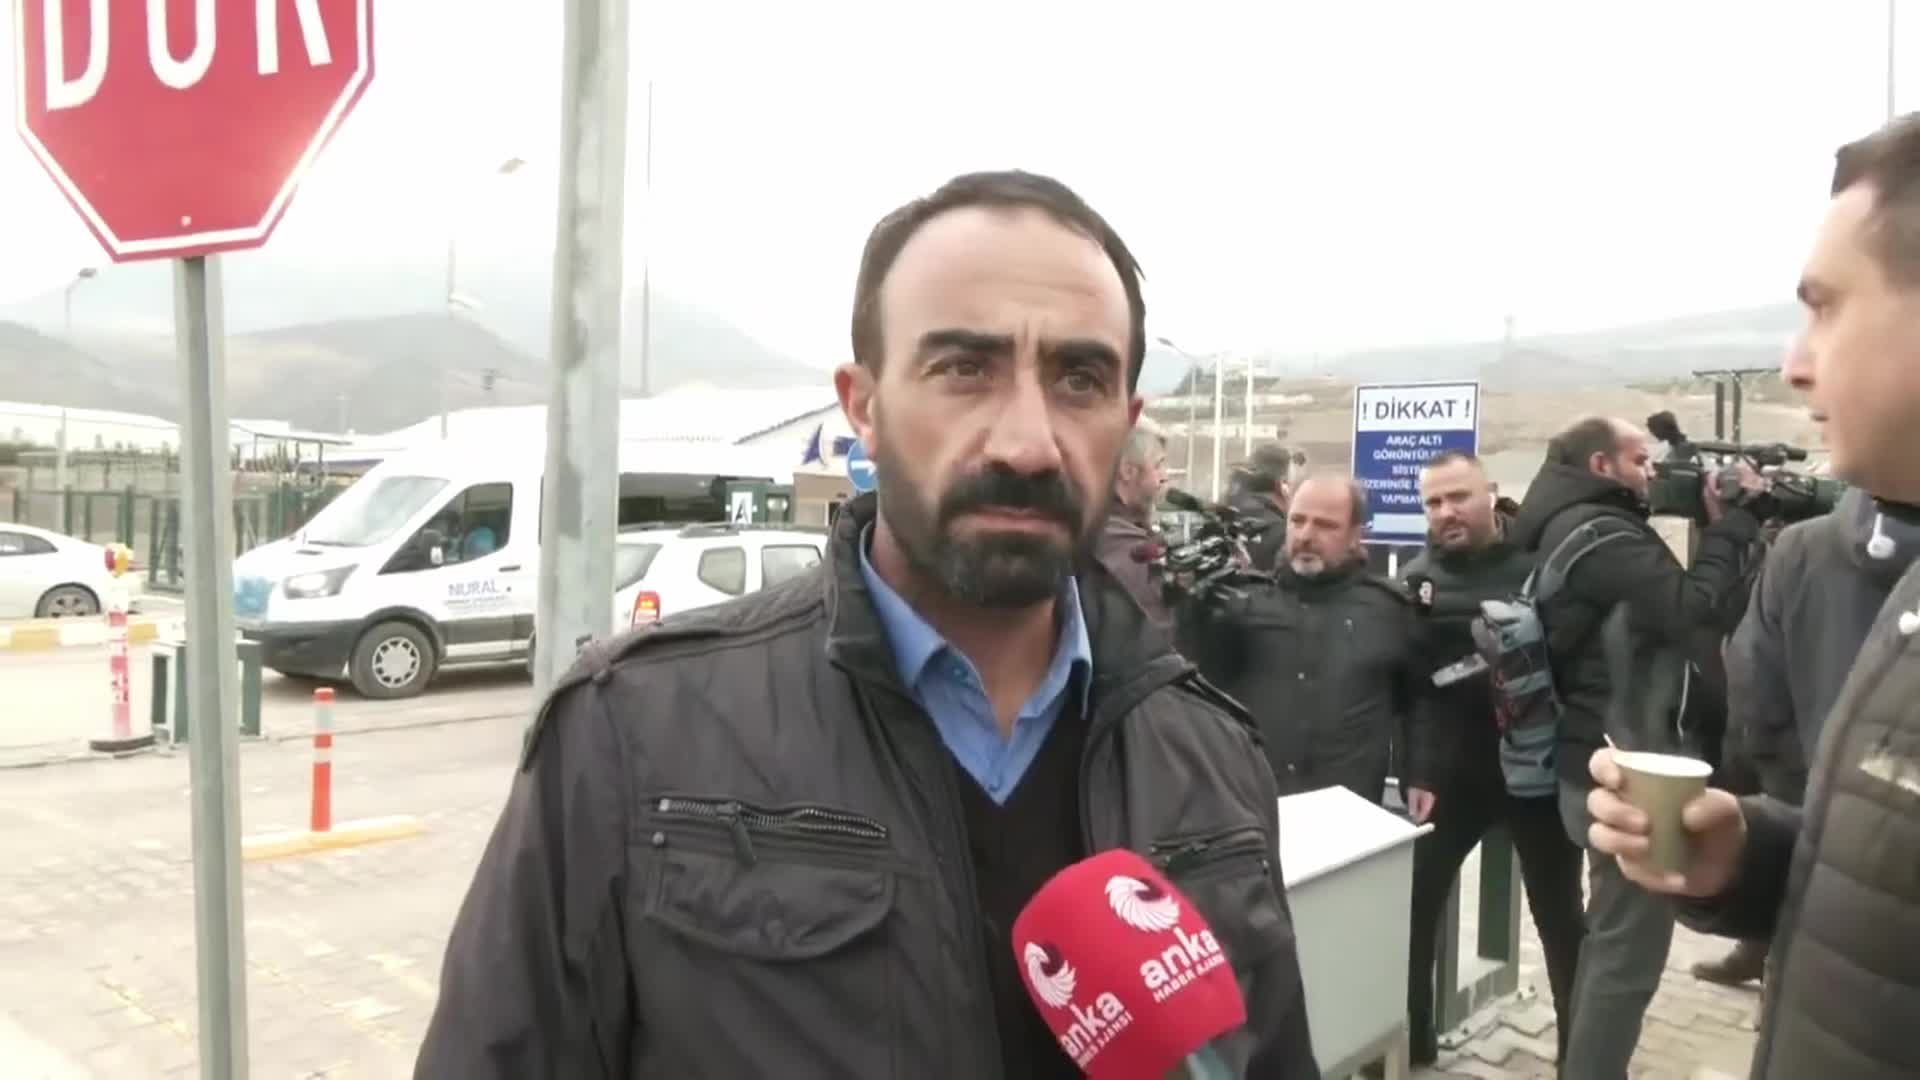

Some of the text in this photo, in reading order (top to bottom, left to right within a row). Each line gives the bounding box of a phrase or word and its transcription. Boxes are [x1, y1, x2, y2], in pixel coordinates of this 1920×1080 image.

[1375, 396, 1457, 420] DİKKAT
[1385, 434, 1442, 448] ARAÇ ALTI
[1373, 448, 1441, 461] GÖRÜNTÜLE
[1391, 464, 1421, 475] SİSTE
[447, 578, 498, 597] NURAL
[1140, 926, 1221, 989] anka
[1152, 968, 1197, 1004] HABER
[1060, 992, 1125, 1058] anka
